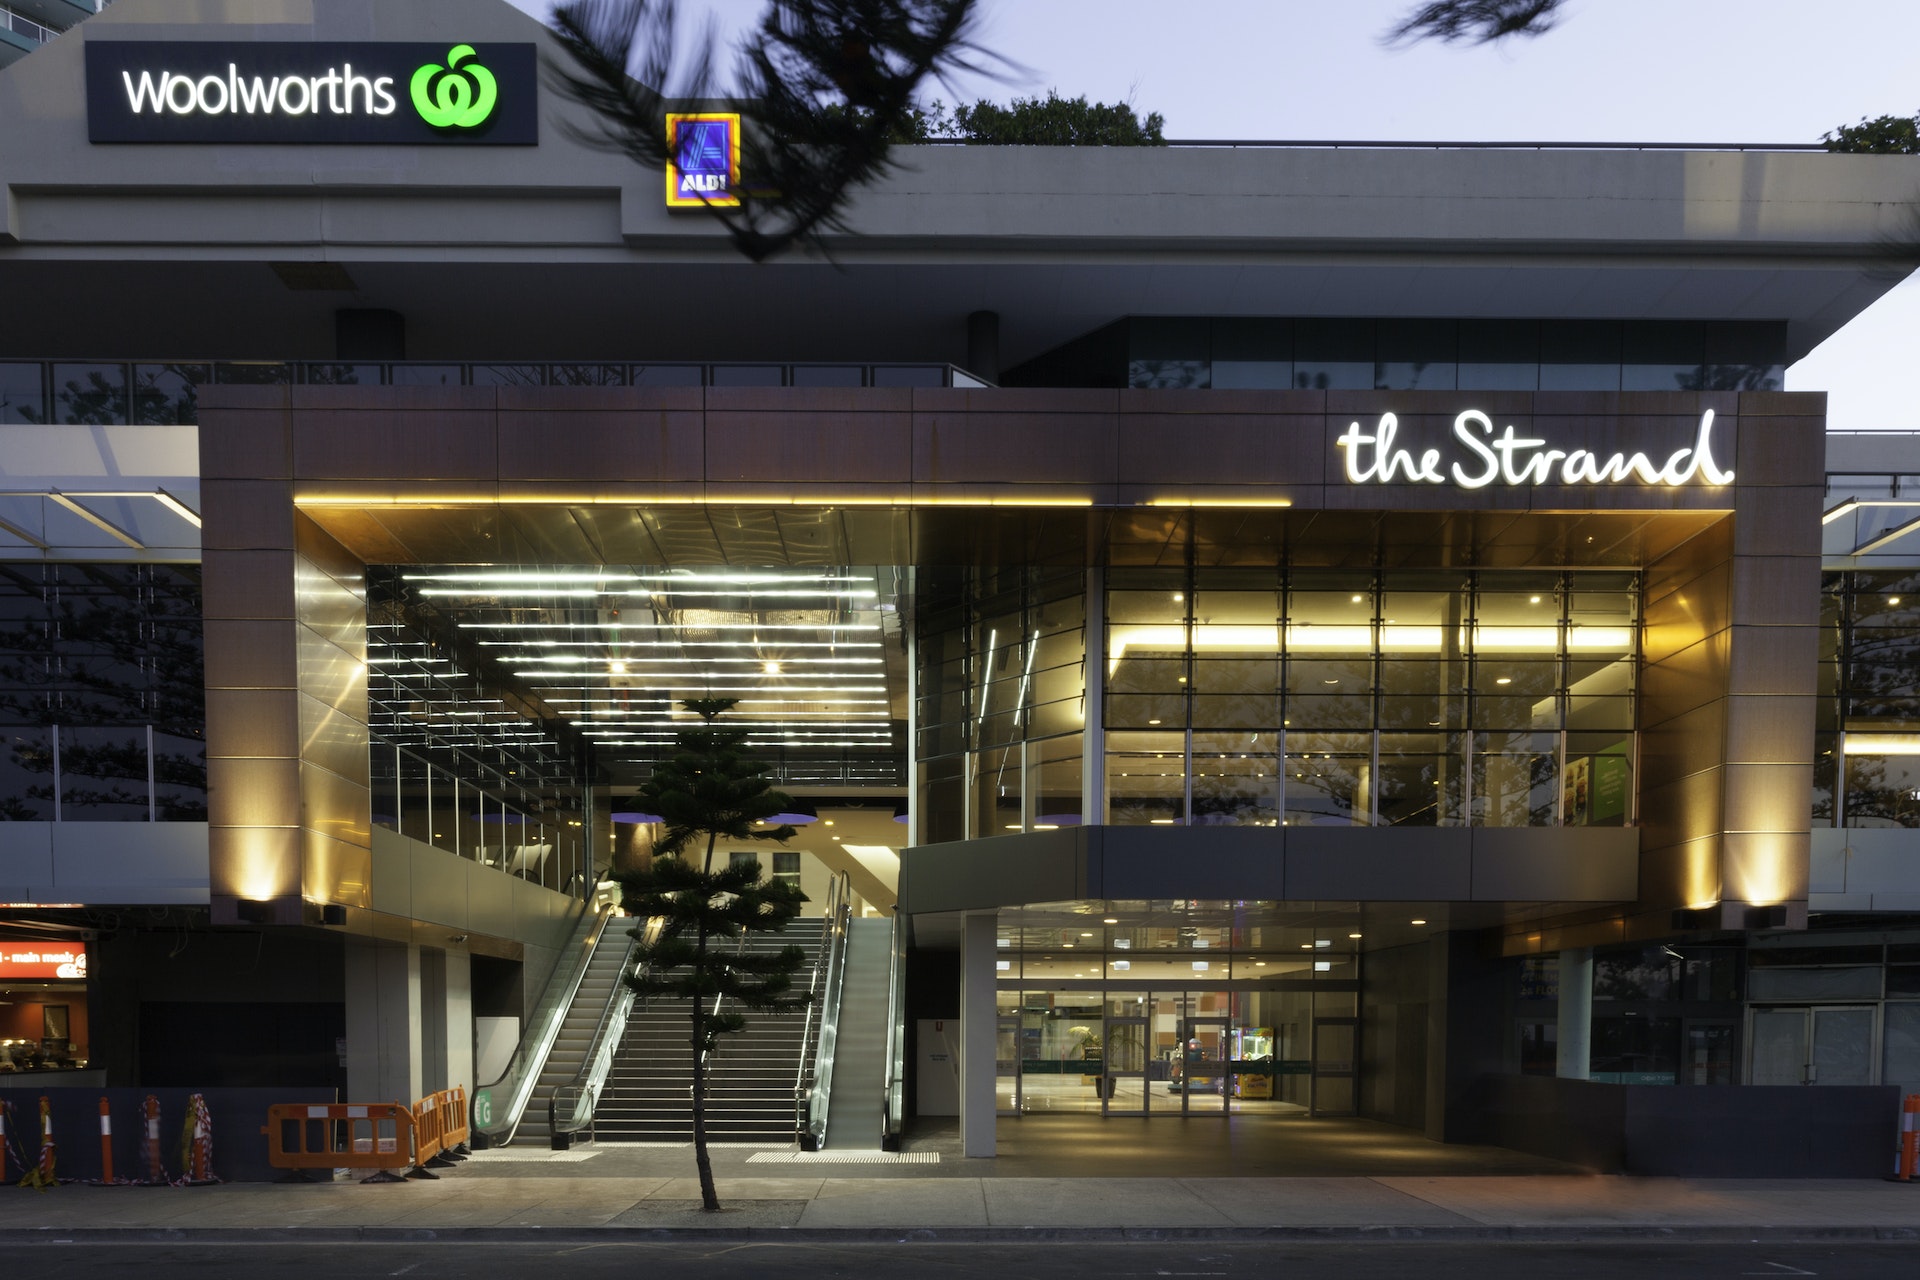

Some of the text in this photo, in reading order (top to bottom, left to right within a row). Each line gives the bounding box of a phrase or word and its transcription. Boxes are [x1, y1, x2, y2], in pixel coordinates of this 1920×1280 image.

[122, 63, 396, 114] Woolworths
[681, 174, 726, 191] ALDI
[1338, 409, 1735, 489] the Strand
[11, 951, 40, 963] main
[42, 951, 74, 963] meals
